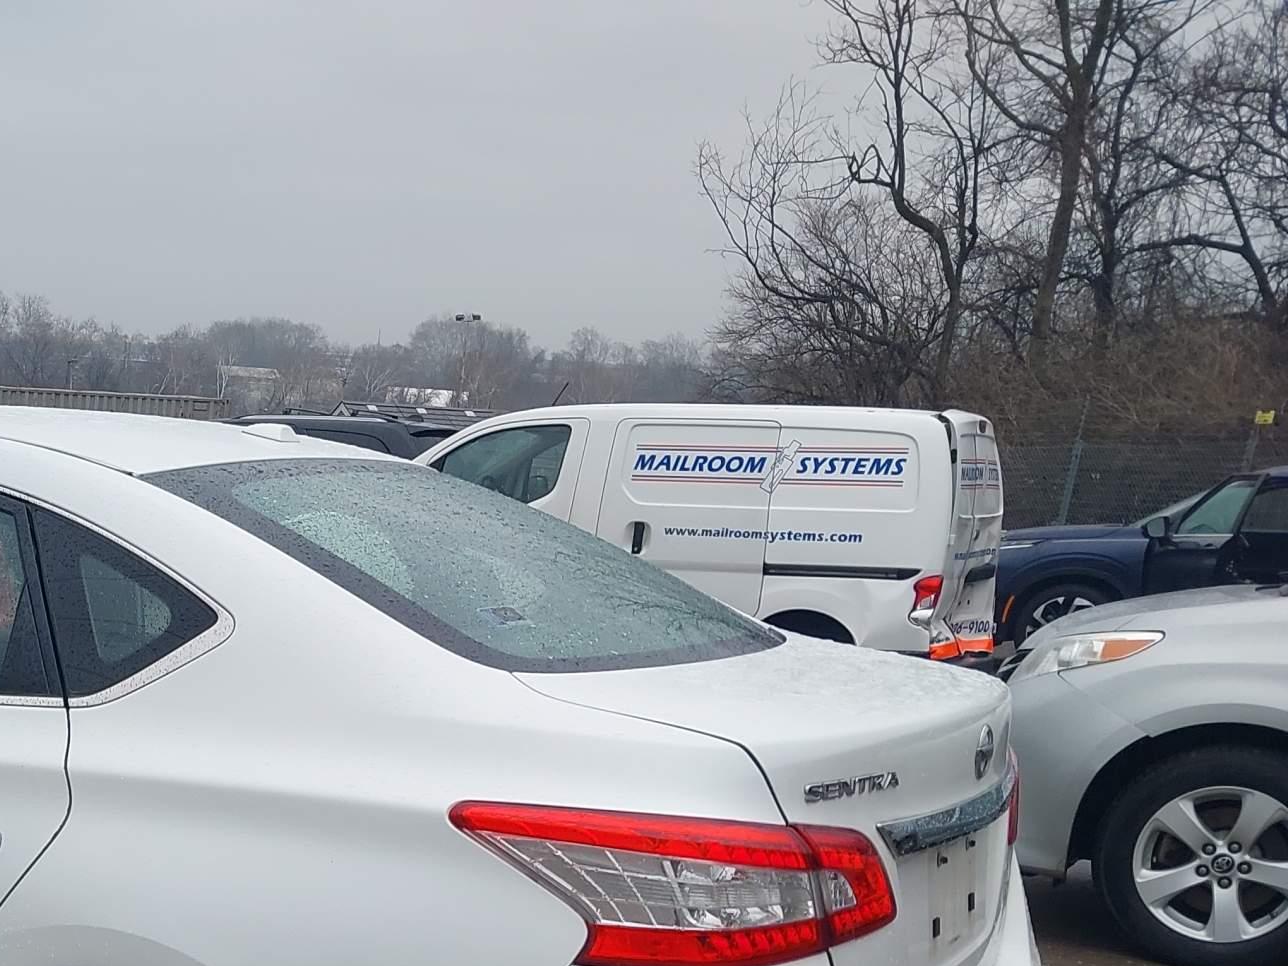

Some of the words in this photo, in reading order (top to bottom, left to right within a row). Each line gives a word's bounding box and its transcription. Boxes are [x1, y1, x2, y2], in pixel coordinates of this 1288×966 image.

[634, 454, 767, 474] MAILROOM
[796, 456, 907, 475] SYSTEMS
[664, 527, 863, 544] www.mailroomsystems.com
[804, 772, 899, 803] SENTRA
